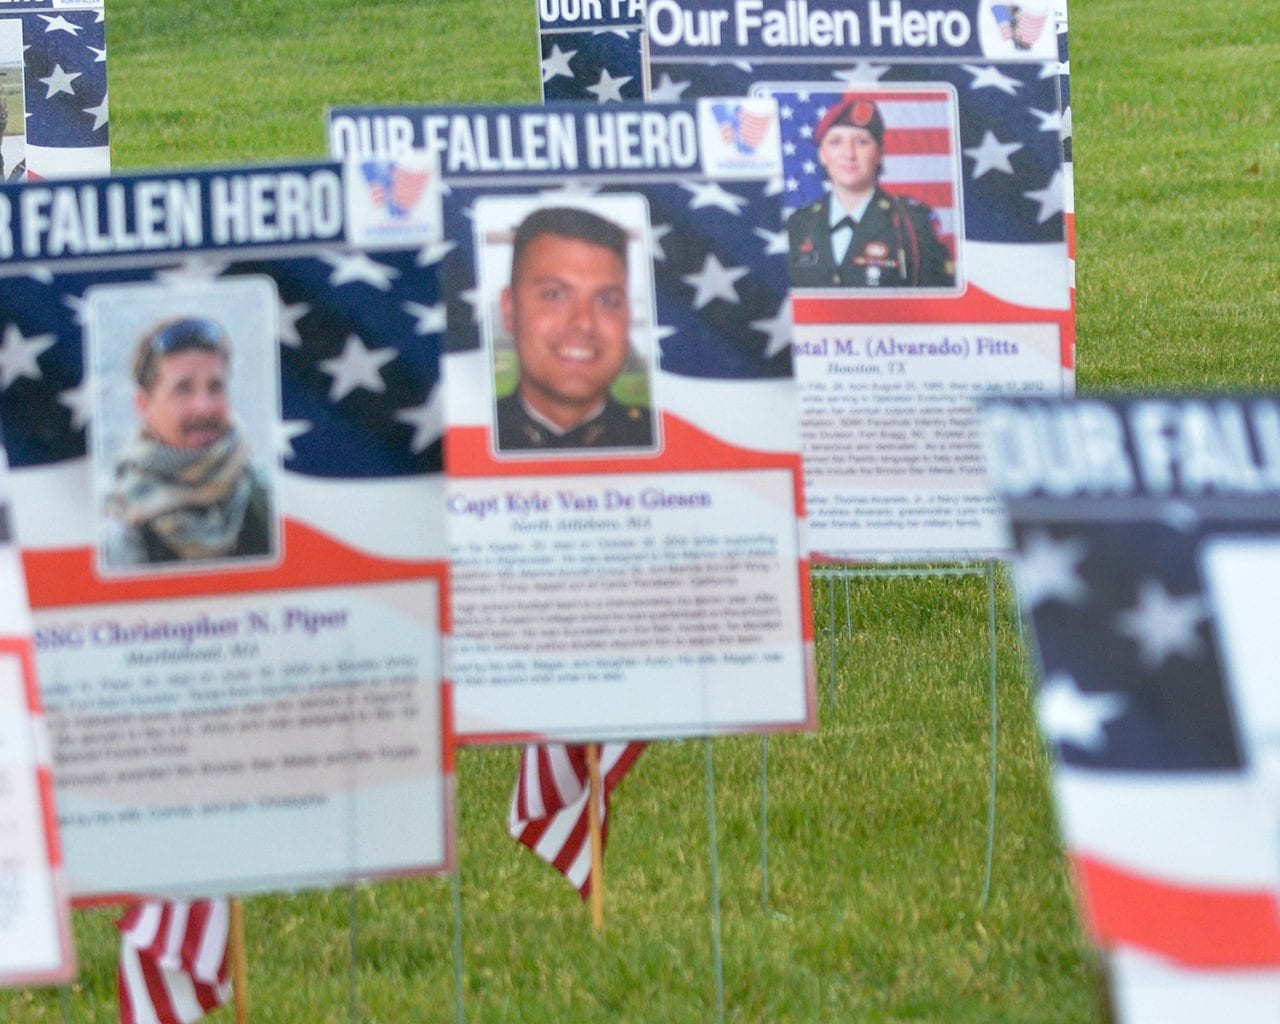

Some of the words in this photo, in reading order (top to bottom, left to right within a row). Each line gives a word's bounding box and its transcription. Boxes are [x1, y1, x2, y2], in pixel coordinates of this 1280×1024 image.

[332, 114, 414, 159] OUR
[423, 112, 579, 171] FALLEN
[585, 111, 698, 169] HERO
[21, 178, 203, 257] FALLEN
[210, 169, 343, 245] HERO
[793, 339, 828, 356] stal
[866, 337, 970, 358] (Alvarado)
[977, 337, 1019, 356] Fitts
[983, 400, 1139, 497] OUR
[448, 494, 499, 520] Capt
[507, 492, 549, 515] Kyle
[558, 492, 598, 511] Van
[605, 490, 633, 509] De
[639, 488, 712, 509] Giesen
[90, 614, 239, 649] Christopher
[282, 607, 347, 639] Piper
